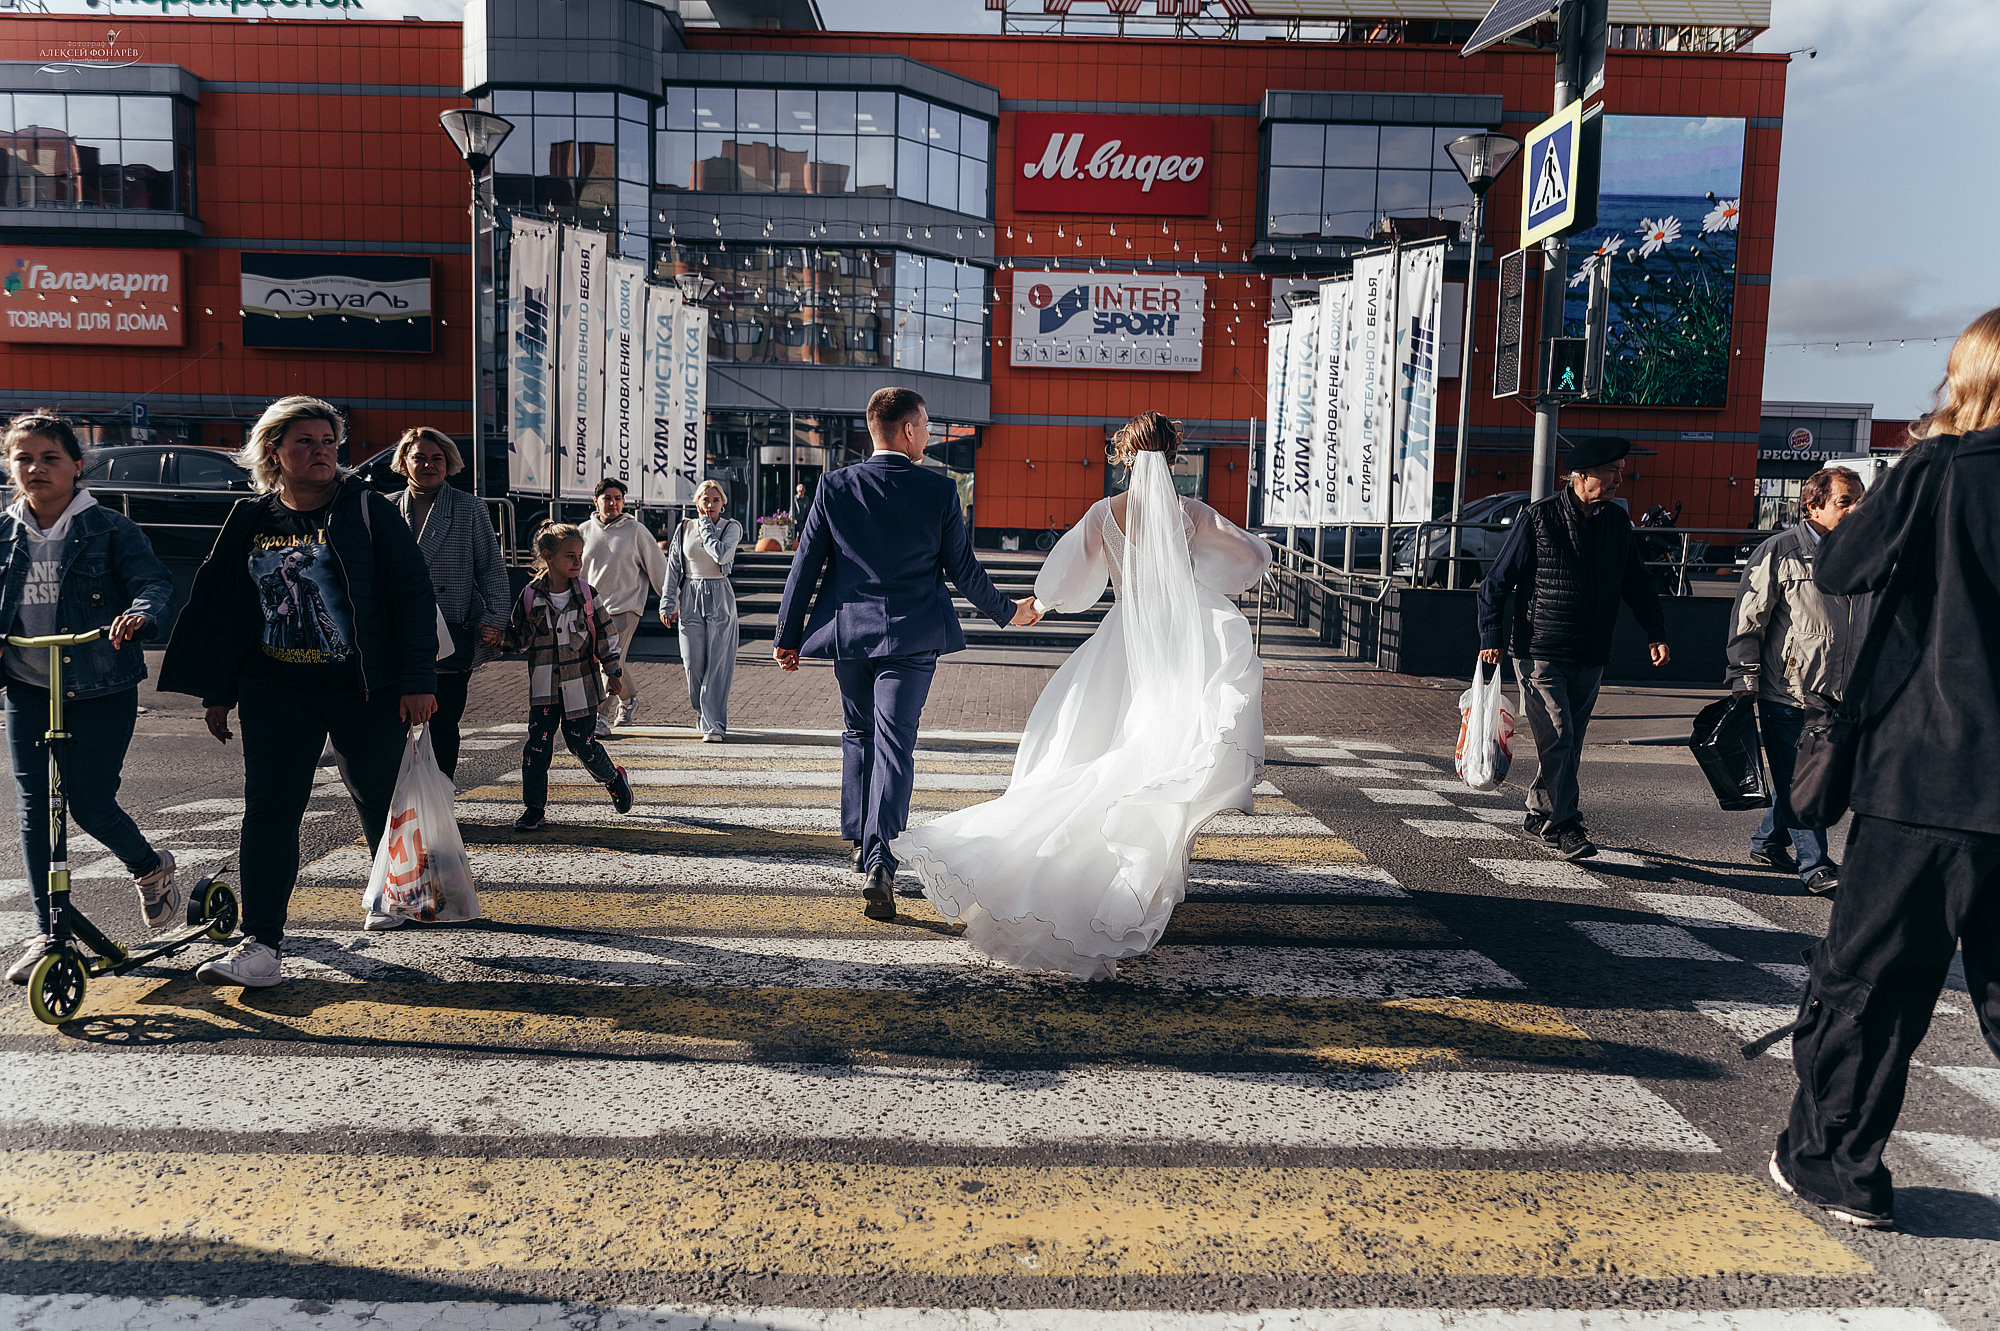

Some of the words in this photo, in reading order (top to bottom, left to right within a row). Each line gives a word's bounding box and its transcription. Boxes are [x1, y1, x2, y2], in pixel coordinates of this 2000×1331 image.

[1023, 133, 1204, 192] М.видео
[29, 265, 169, 298] Галамарт
[580, 249, 591, 300] БЕЛЬЯ
[1095, 286, 1181, 312] INTER
[7, 311, 71, 329] ТОВАРЫ
[77, 312, 111, 331] ДЛЯ
[116, 313, 168, 331] ДОМА
[620, 279, 631, 330] КОЖИ
[1093, 312, 1180, 336] SPORT
[1329, 301, 1342, 351] КОЖИ
[1367, 277, 1378, 326] БЕЛЬЯ
[577, 303, 589, 413] ПОСТЕЛЬНОГО
[619, 332, 630, 482] ВОССТАНОВЛЕНИЕ
[1363, 330, 1376, 440] ПОСТЕЛЬНОГО
[576, 417, 587, 476] СТИРКА
[1326, 354, 1340, 503] ВОССТАНОВЛЕНИЕ
[1361, 443, 1372, 503] СТИРКА
[1762, 449, 1842, 460] РЕСТОРАН
[254, 533, 301, 550] Король
